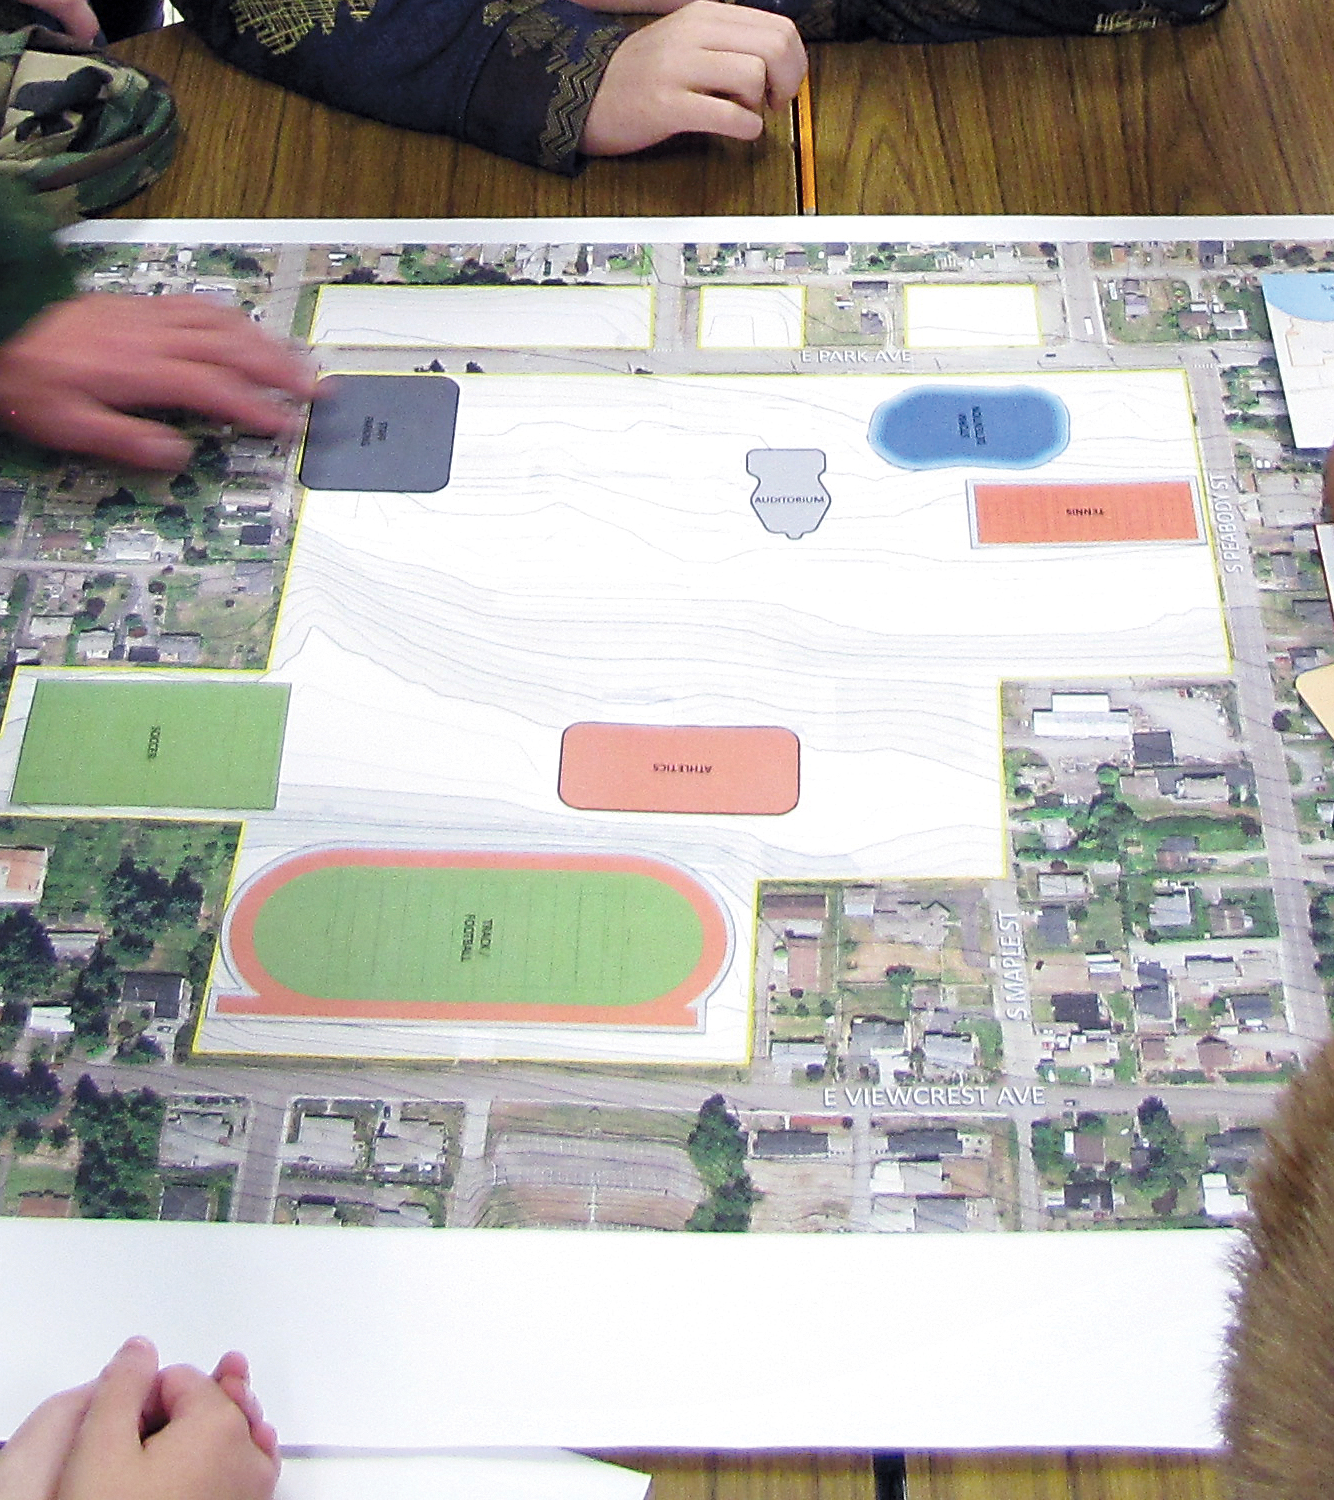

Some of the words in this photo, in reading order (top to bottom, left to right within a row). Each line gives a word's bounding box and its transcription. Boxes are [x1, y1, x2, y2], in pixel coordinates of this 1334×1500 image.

[801, 350, 812, 363] E
[817, 350, 869, 363] PARK
[873, 350, 913, 363] AVE
[1208, 473, 1229, 490] ST
[754, 495, 825, 505] AUDITORIUM
[1066, 507, 1105, 517] TENNIS
[1212, 493, 1241, 561] PEABODY
[1224, 563, 1244, 575] S
[653, 763, 713, 774] ATHLETICS
[997, 909, 1020, 932] ST
[998, 935, 1027, 1004] MAPLE
[1006, 1007, 1028, 1021] S
[823, 1087, 837, 1106] E
[844, 1086, 989, 1106] VIEWCREST
[996, 1086, 1047, 1106] AVE
